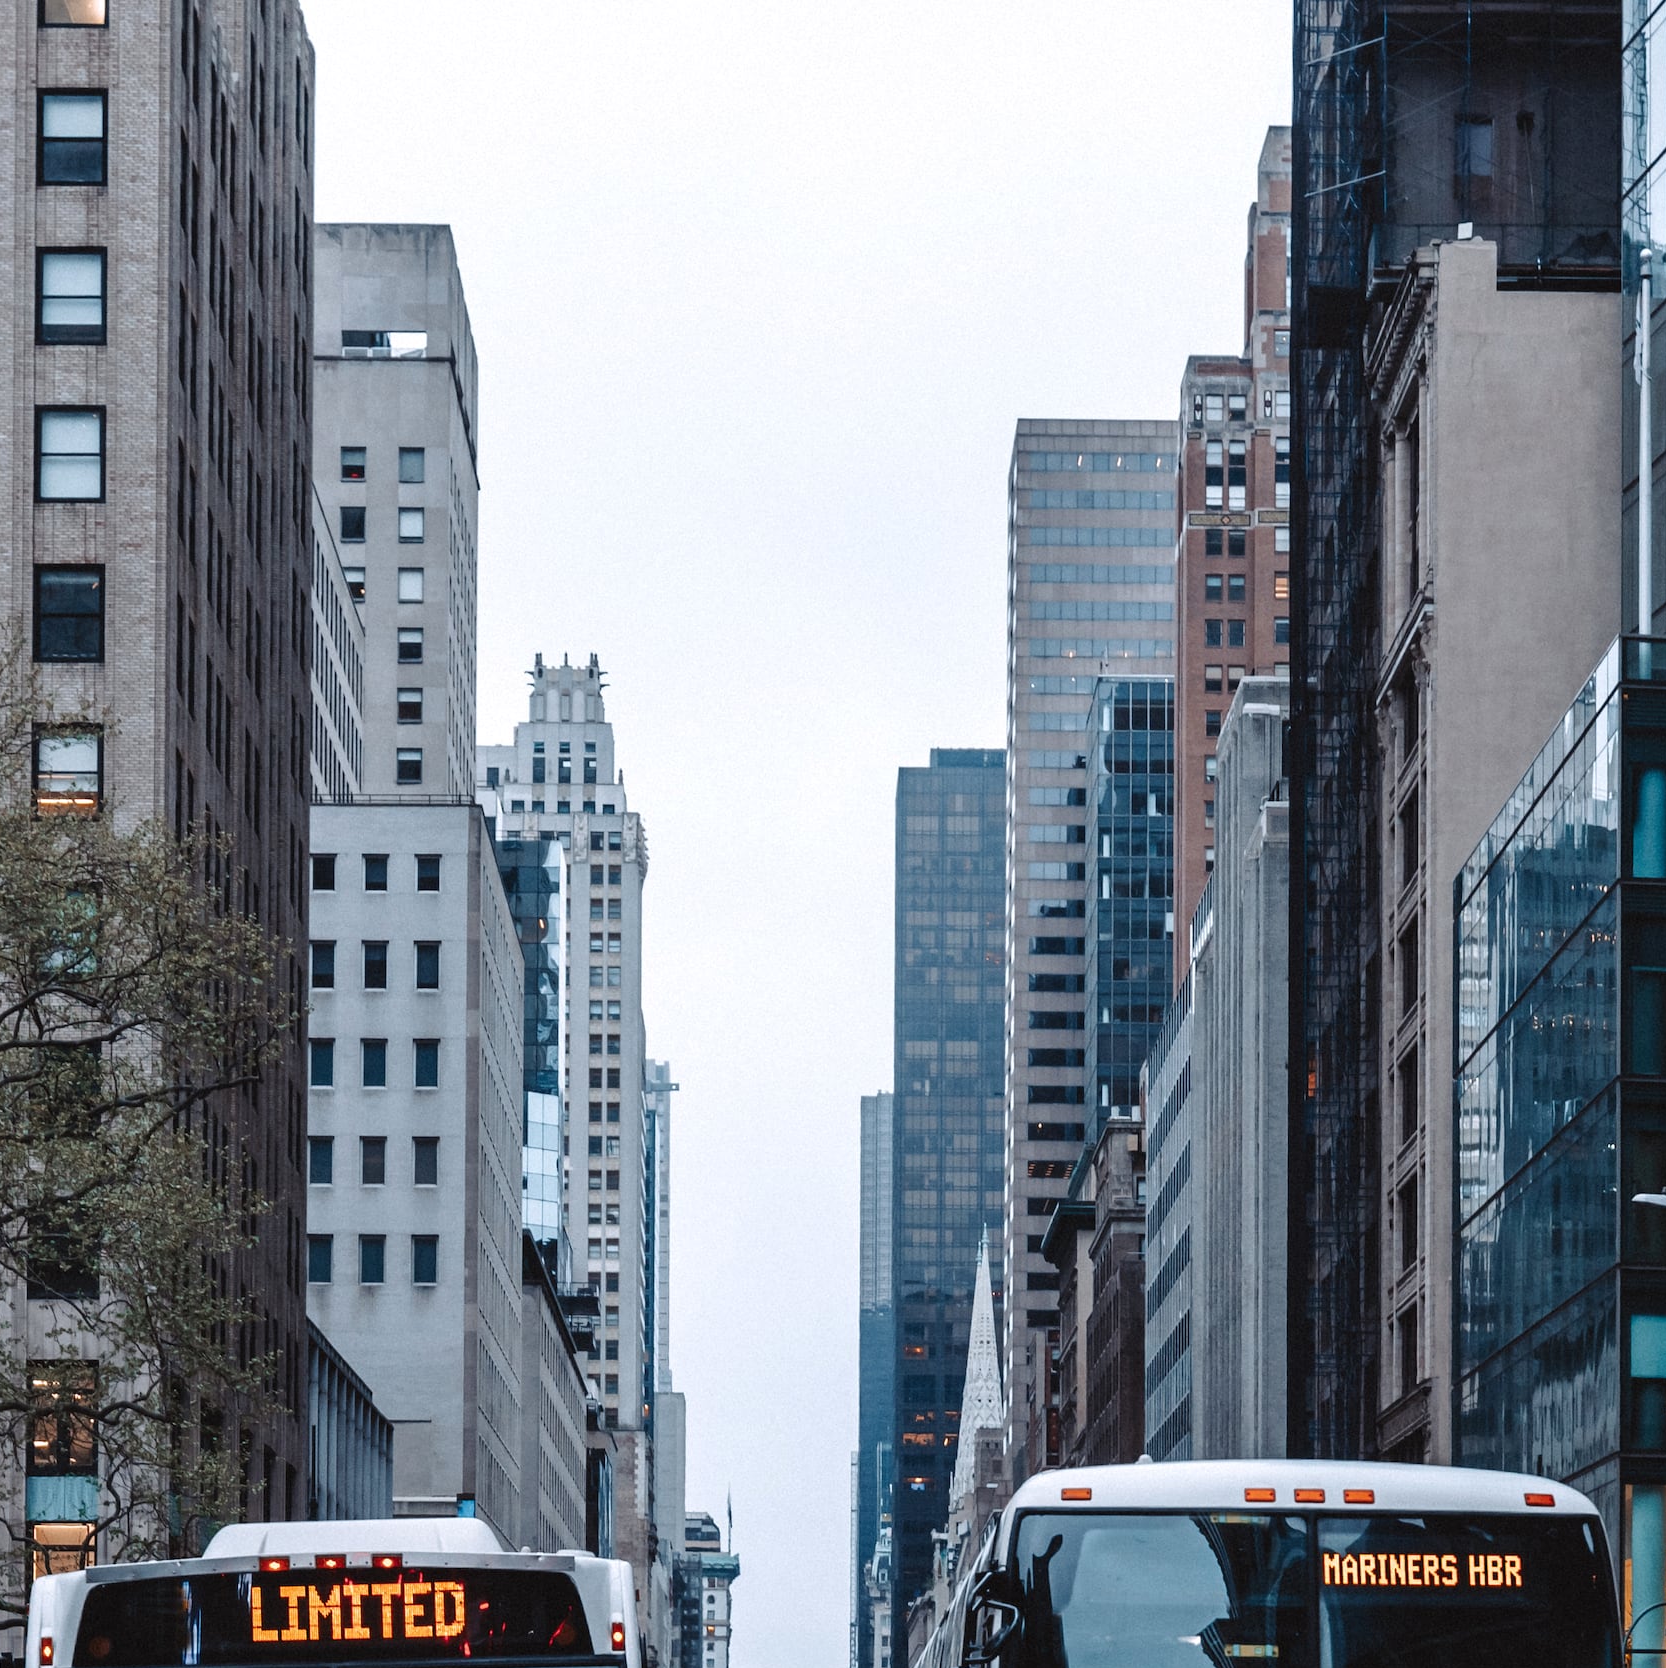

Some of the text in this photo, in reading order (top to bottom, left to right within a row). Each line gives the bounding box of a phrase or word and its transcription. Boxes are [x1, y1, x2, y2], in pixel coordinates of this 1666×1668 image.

[1323, 1553, 1523, 1587] MARINERS HBR
[251, 1581, 465, 1642] LIMITED
